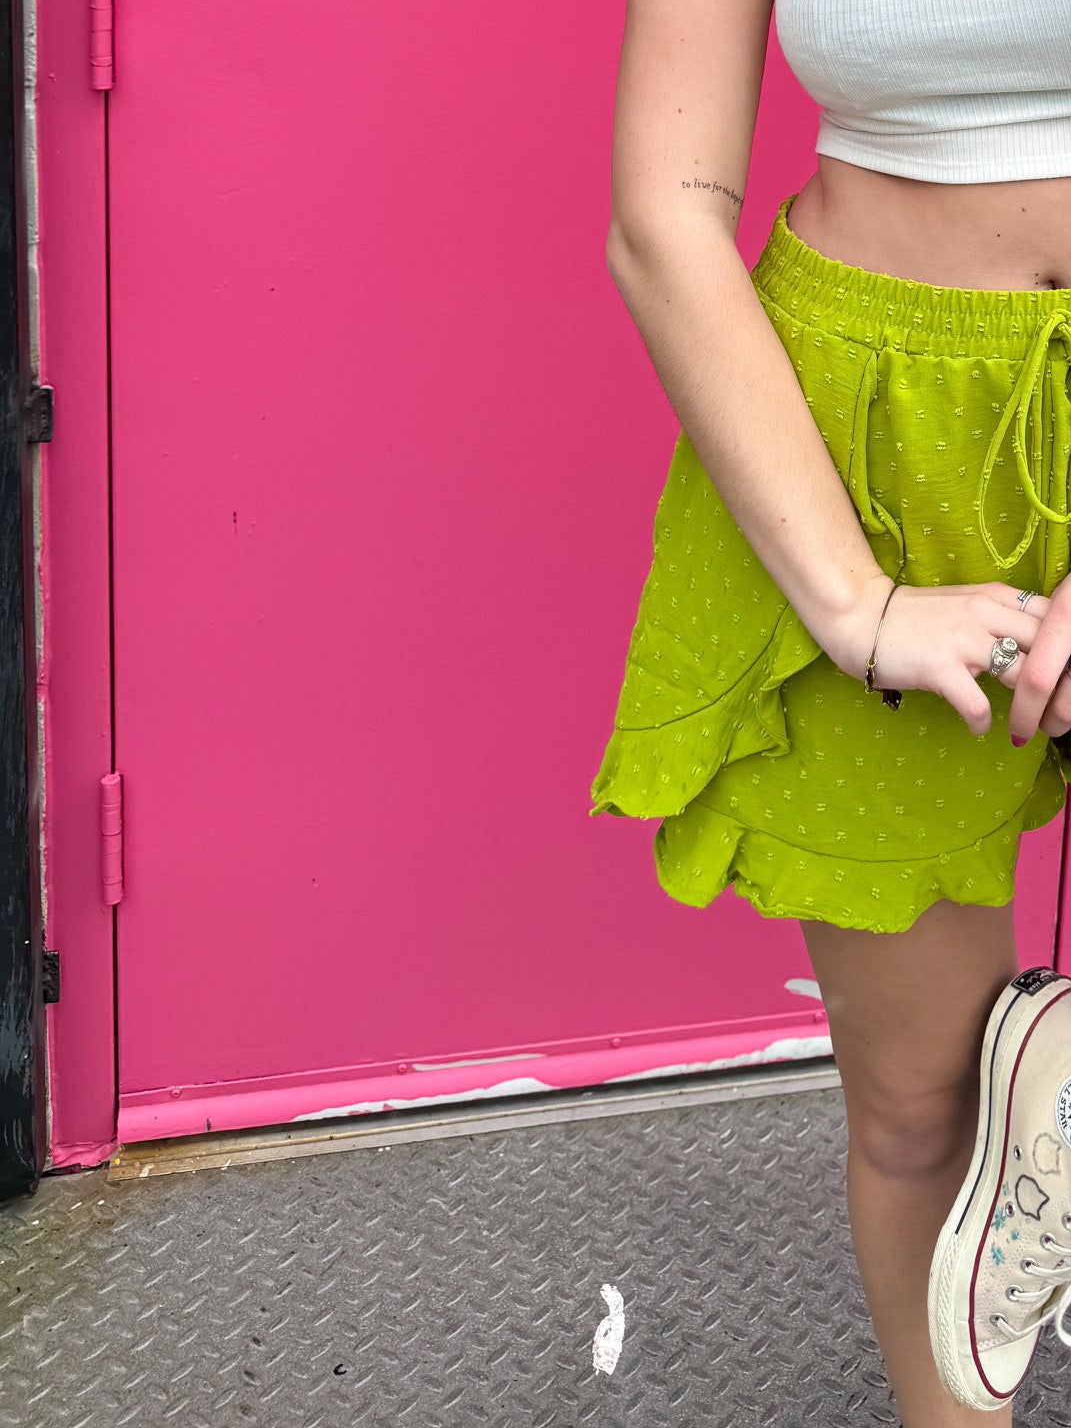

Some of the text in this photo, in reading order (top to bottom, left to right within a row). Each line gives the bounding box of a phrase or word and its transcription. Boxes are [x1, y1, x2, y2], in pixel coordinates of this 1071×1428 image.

[681, 181, 691, 189] to
[693, 178, 711, 190] live
[711, 181, 722, 193] for
[1060, 1097, 1068, 1129] STAR
